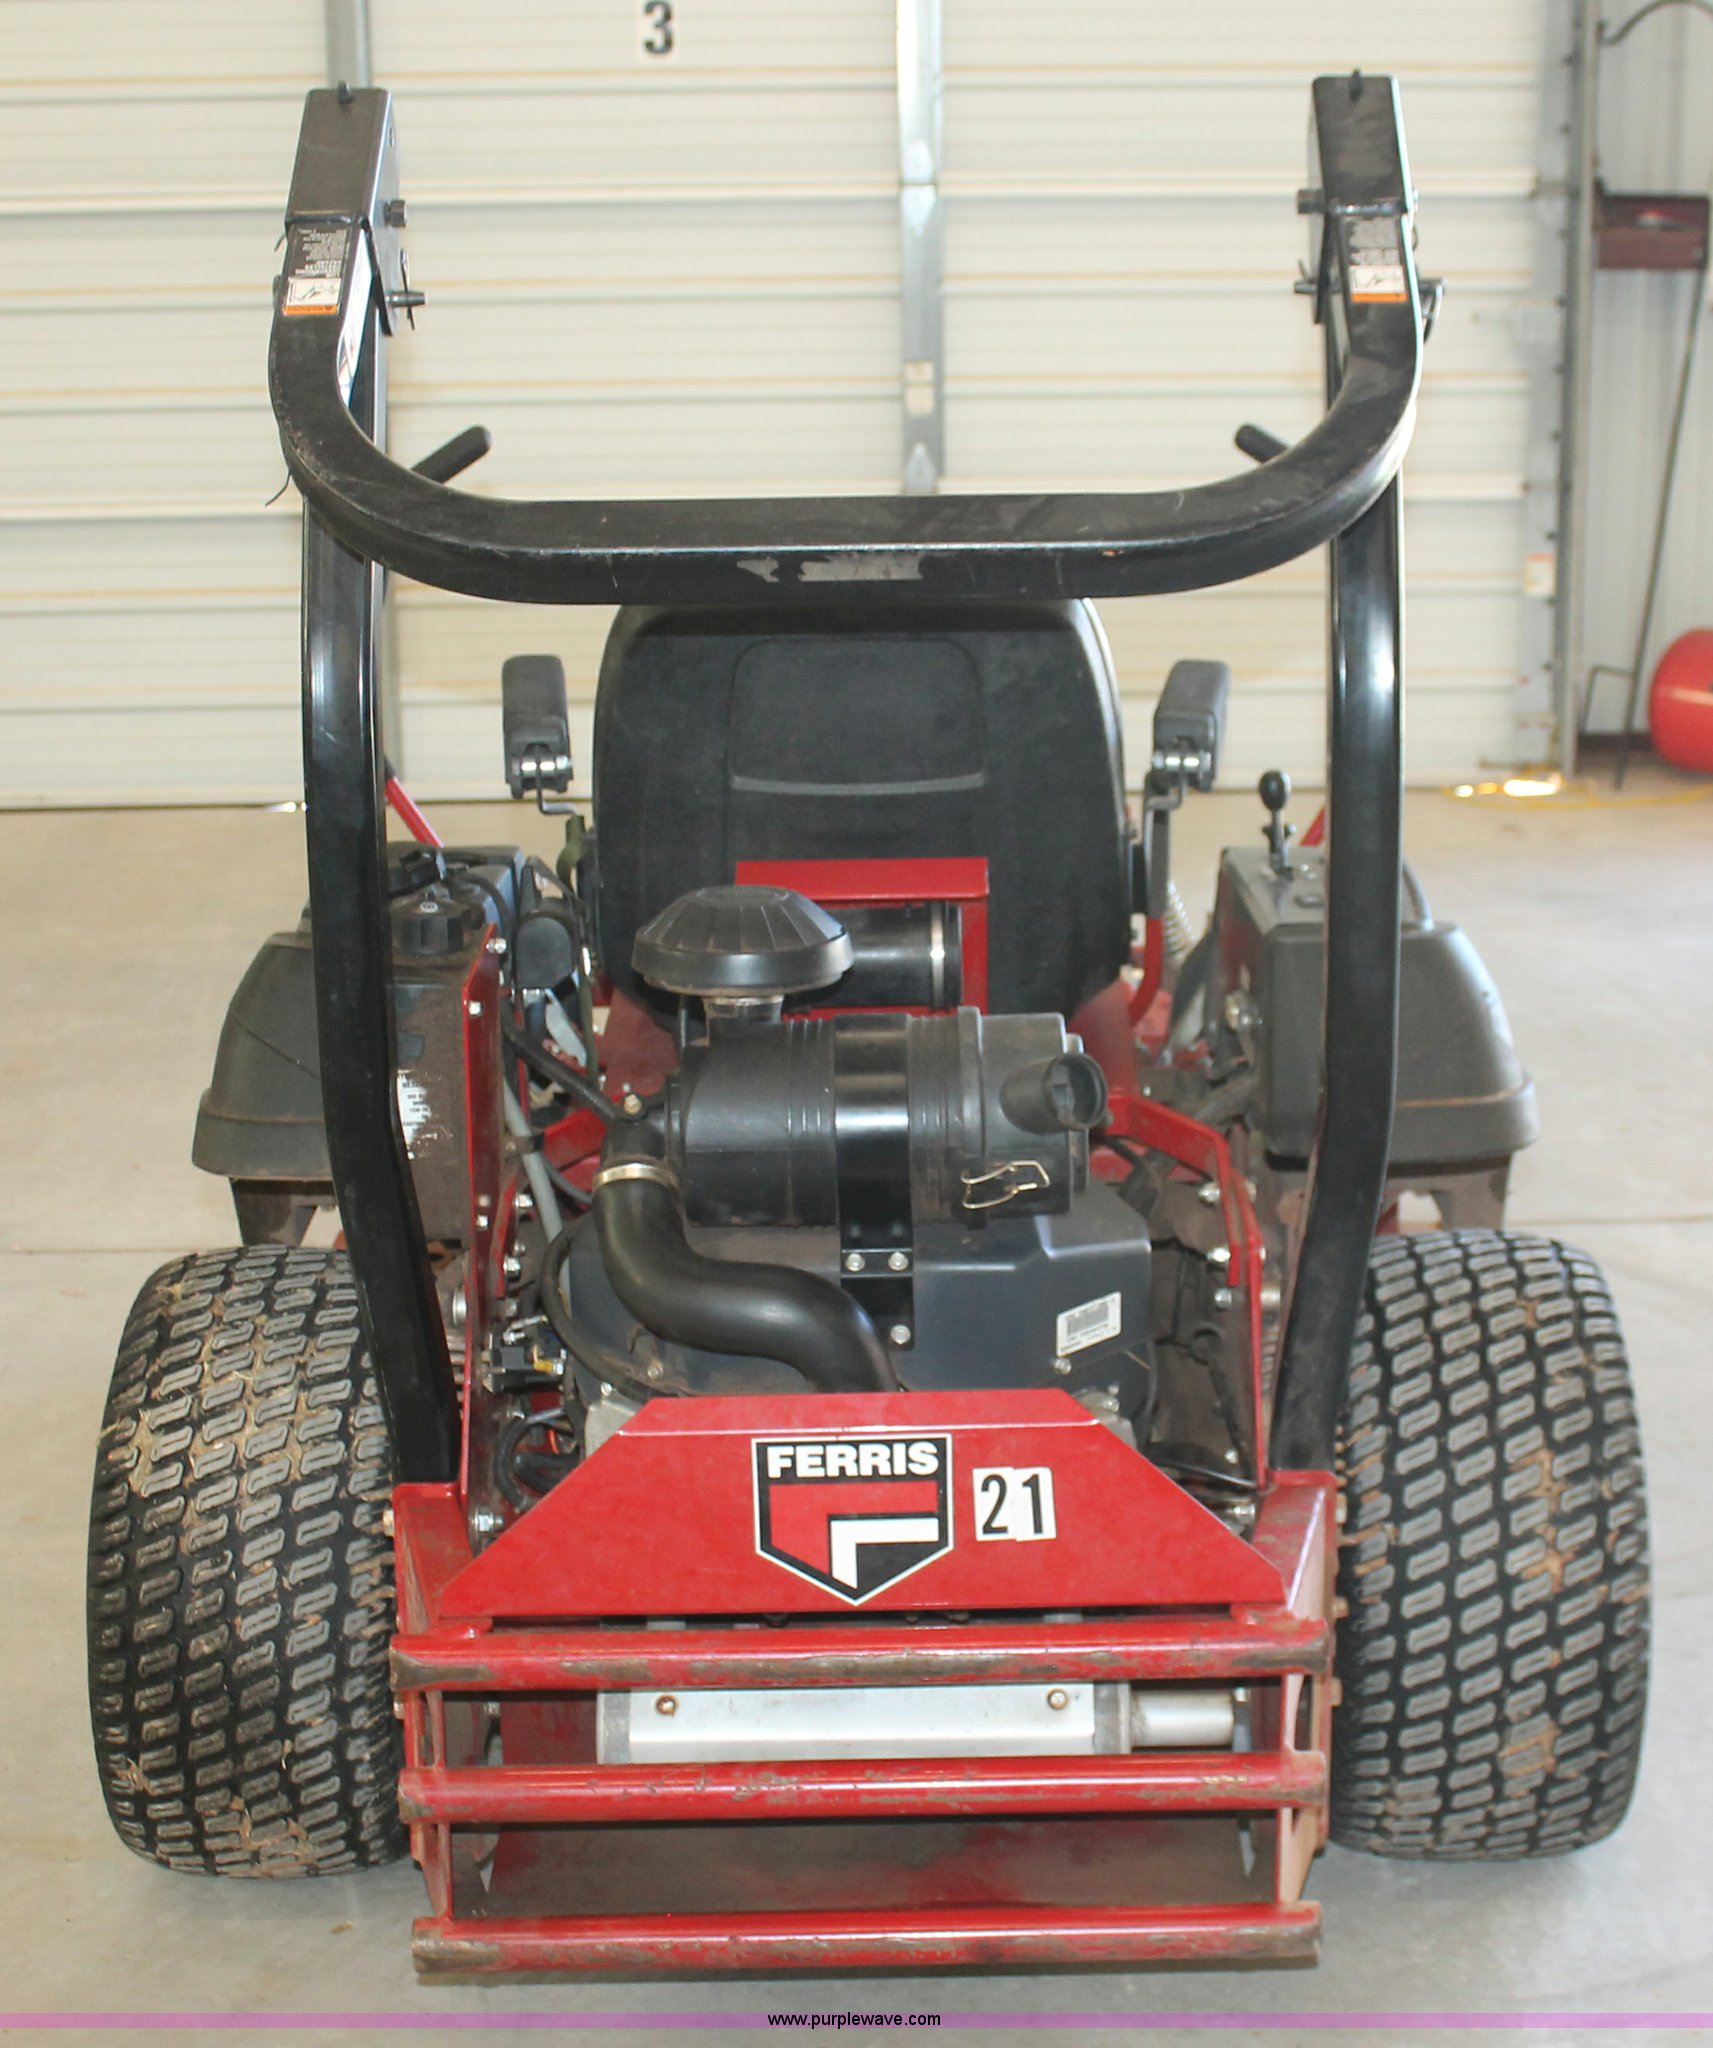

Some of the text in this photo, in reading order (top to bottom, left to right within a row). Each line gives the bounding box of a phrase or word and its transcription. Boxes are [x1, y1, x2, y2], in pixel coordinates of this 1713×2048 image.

[645, 0, 673, 54] 3
[766, 1441, 939, 1479] FERRIS
[981, 1473, 1044, 1535] 21
